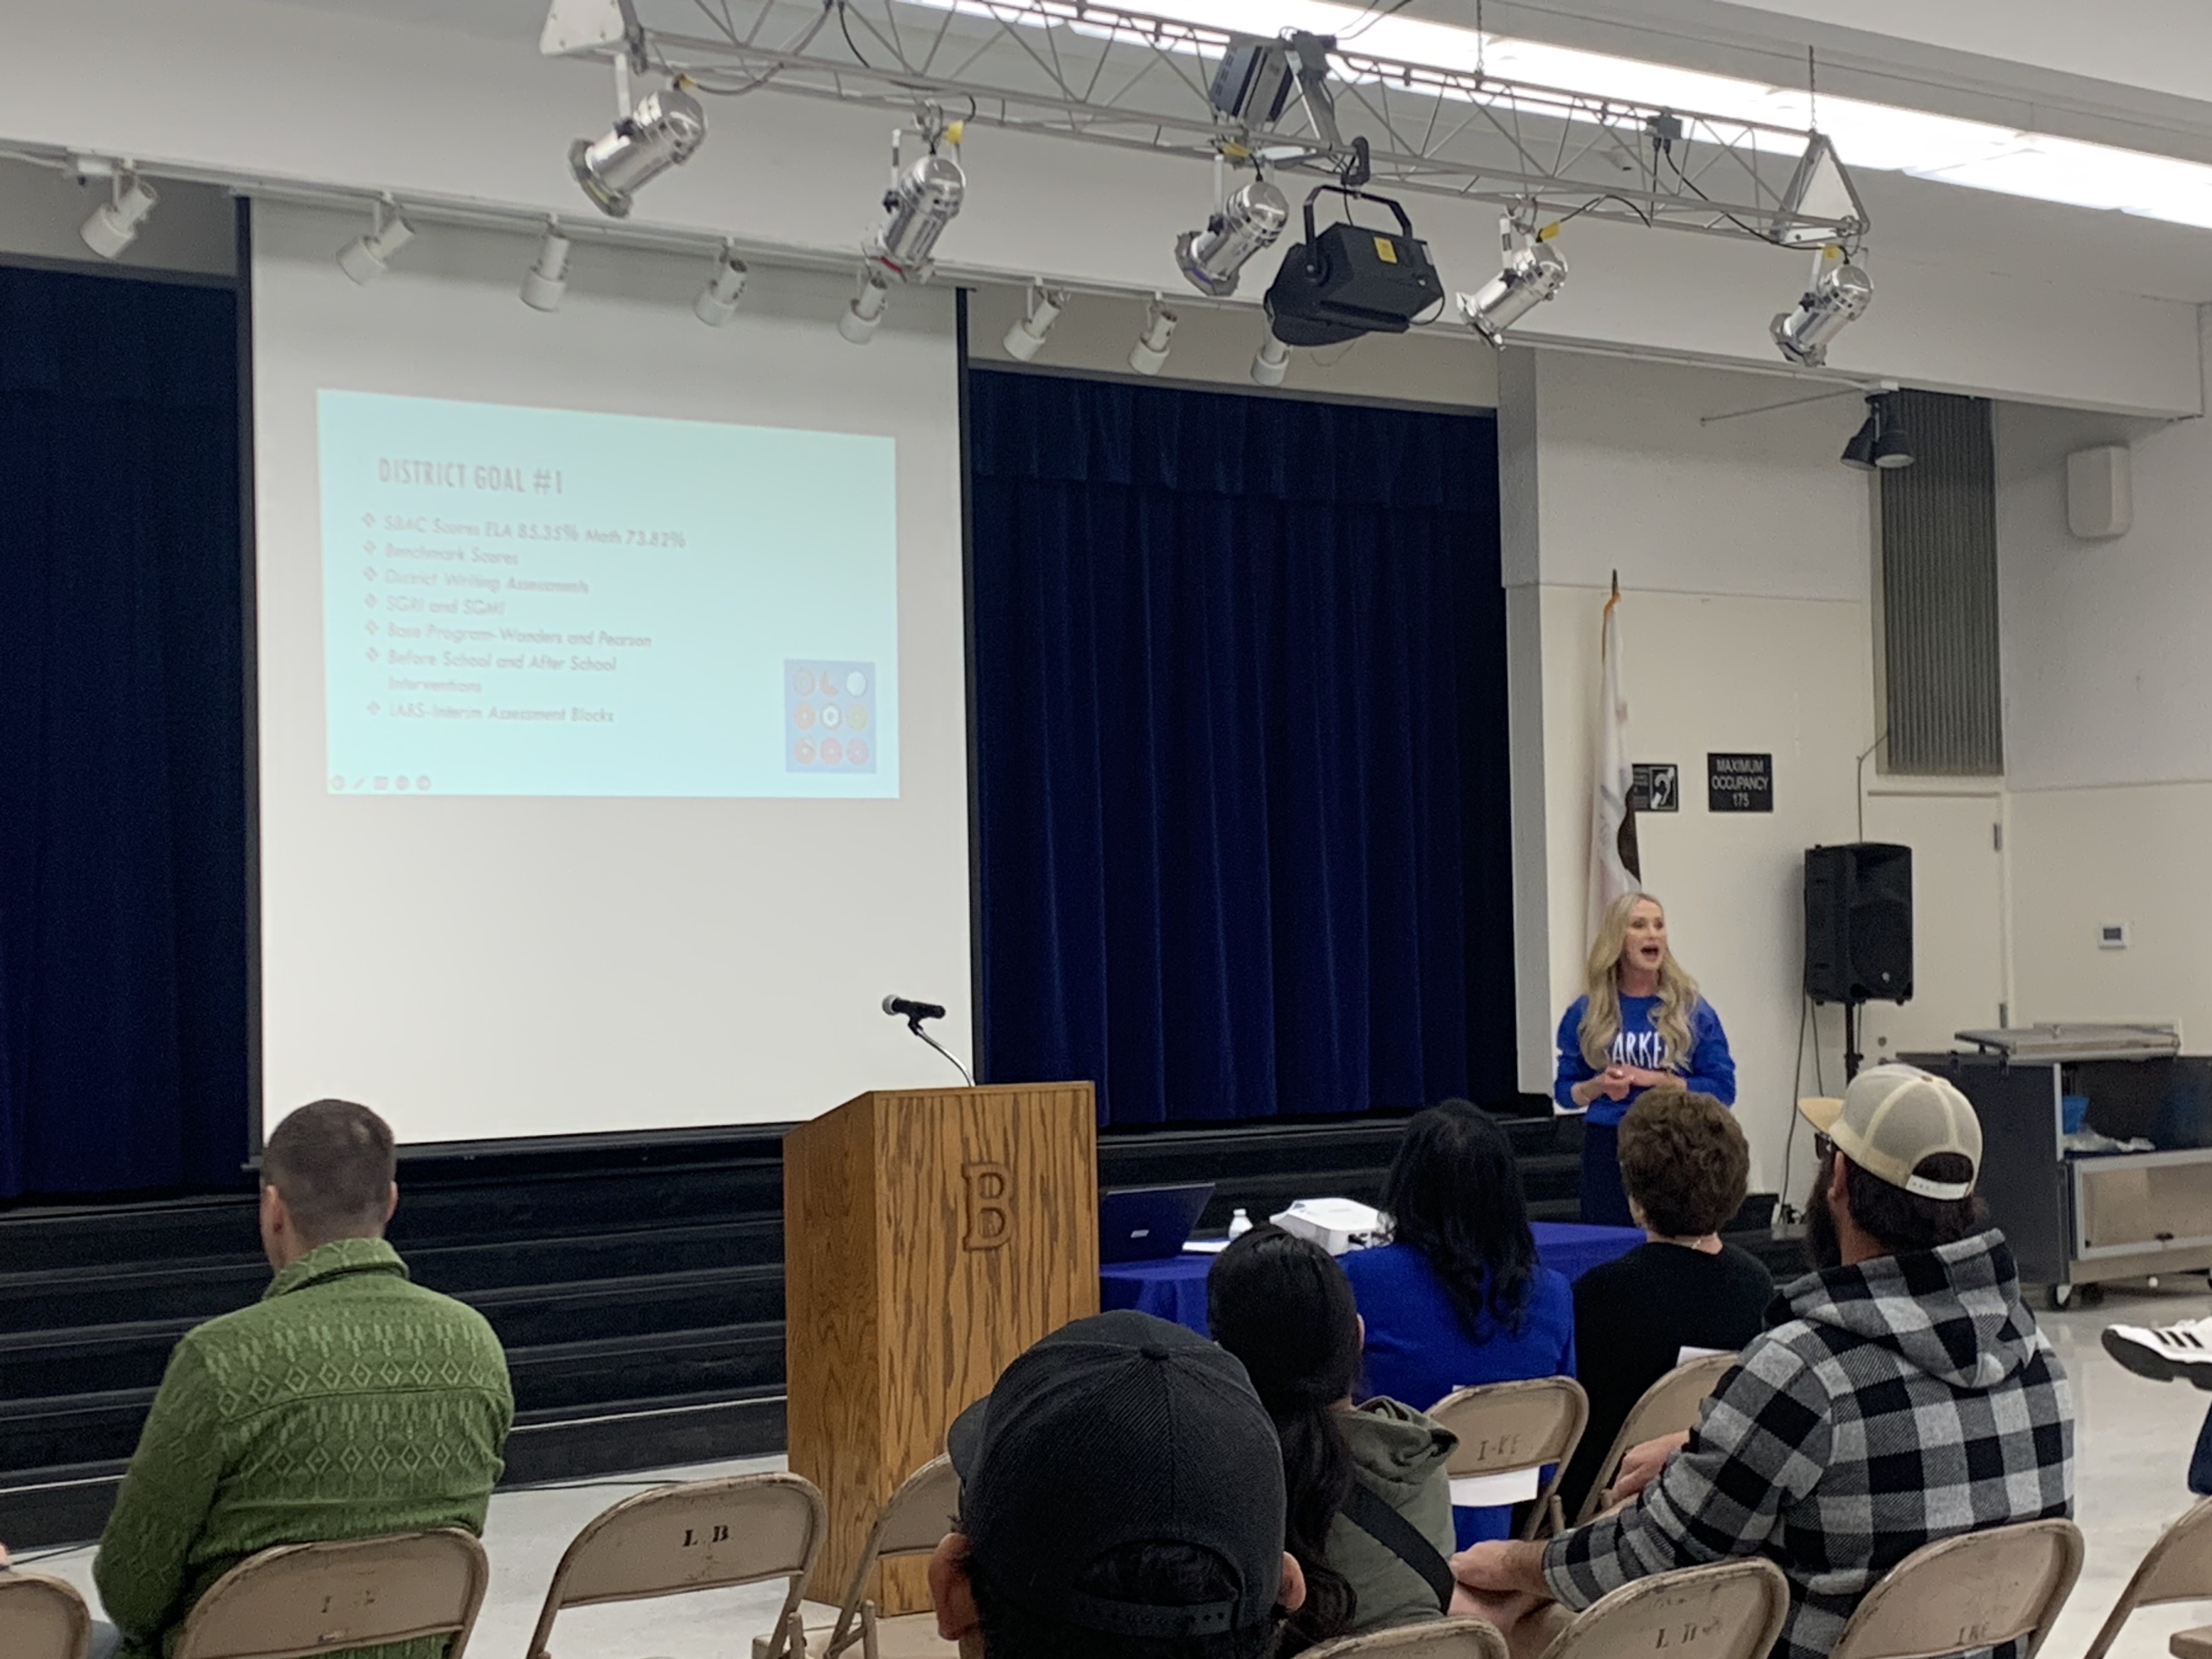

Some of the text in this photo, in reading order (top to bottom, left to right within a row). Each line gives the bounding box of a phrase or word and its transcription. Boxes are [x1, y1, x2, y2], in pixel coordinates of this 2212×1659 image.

[379, 457, 561, 495] DISTRICT GOAL #1
[432, 517, 481, 537] Scores
[485, 521, 512, 538] ELA
[585, 528, 622, 544] Math
[385, 543, 518, 565] Benchmark Scores
[385, 568, 438, 586] District
[443, 572, 501, 593] Writing
[428, 599, 459, 614] and
[567, 629, 594, 645] and
[598, 630, 652, 647] Pearson
[387, 648, 617, 672] Before School and After School
[387, 675, 482, 693] Interventions
[487, 706, 566, 721] Assessment
[571, 707, 614, 724] Blocks
[1716, 759, 1764, 774] MAXIMUM
[1712, 775, 1769, 791] OCCUPANCY
[1733, 792, 1750, 808] 175
[1612, 1030, 1669, 1069] ARKE
[961, 1161, 1016, 1252] B
[682, 1525, 729, 1548] L B
